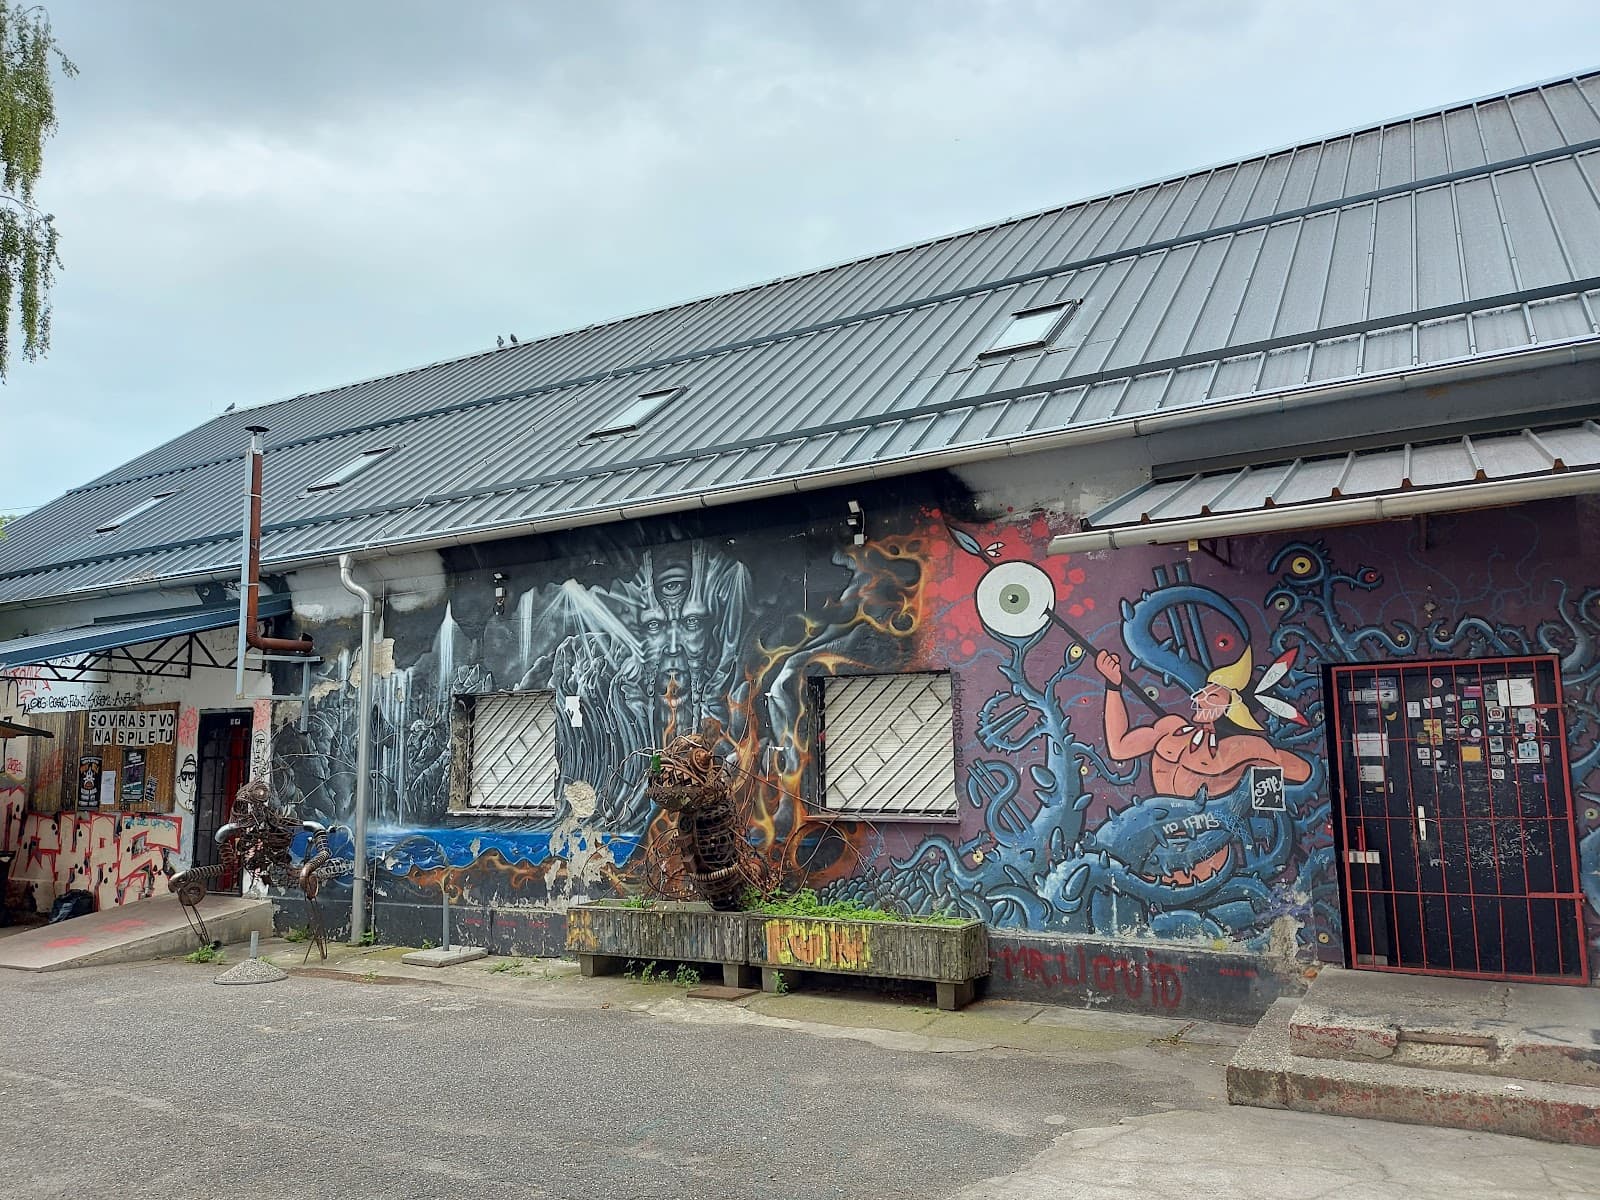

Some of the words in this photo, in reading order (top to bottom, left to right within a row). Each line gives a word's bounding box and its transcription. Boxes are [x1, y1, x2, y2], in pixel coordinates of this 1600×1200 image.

[90, 712, 174, 728] SOVRAŠTVO
[94, 729, 112, 744] NA
[118, 728, 173, 744] SPLETU
